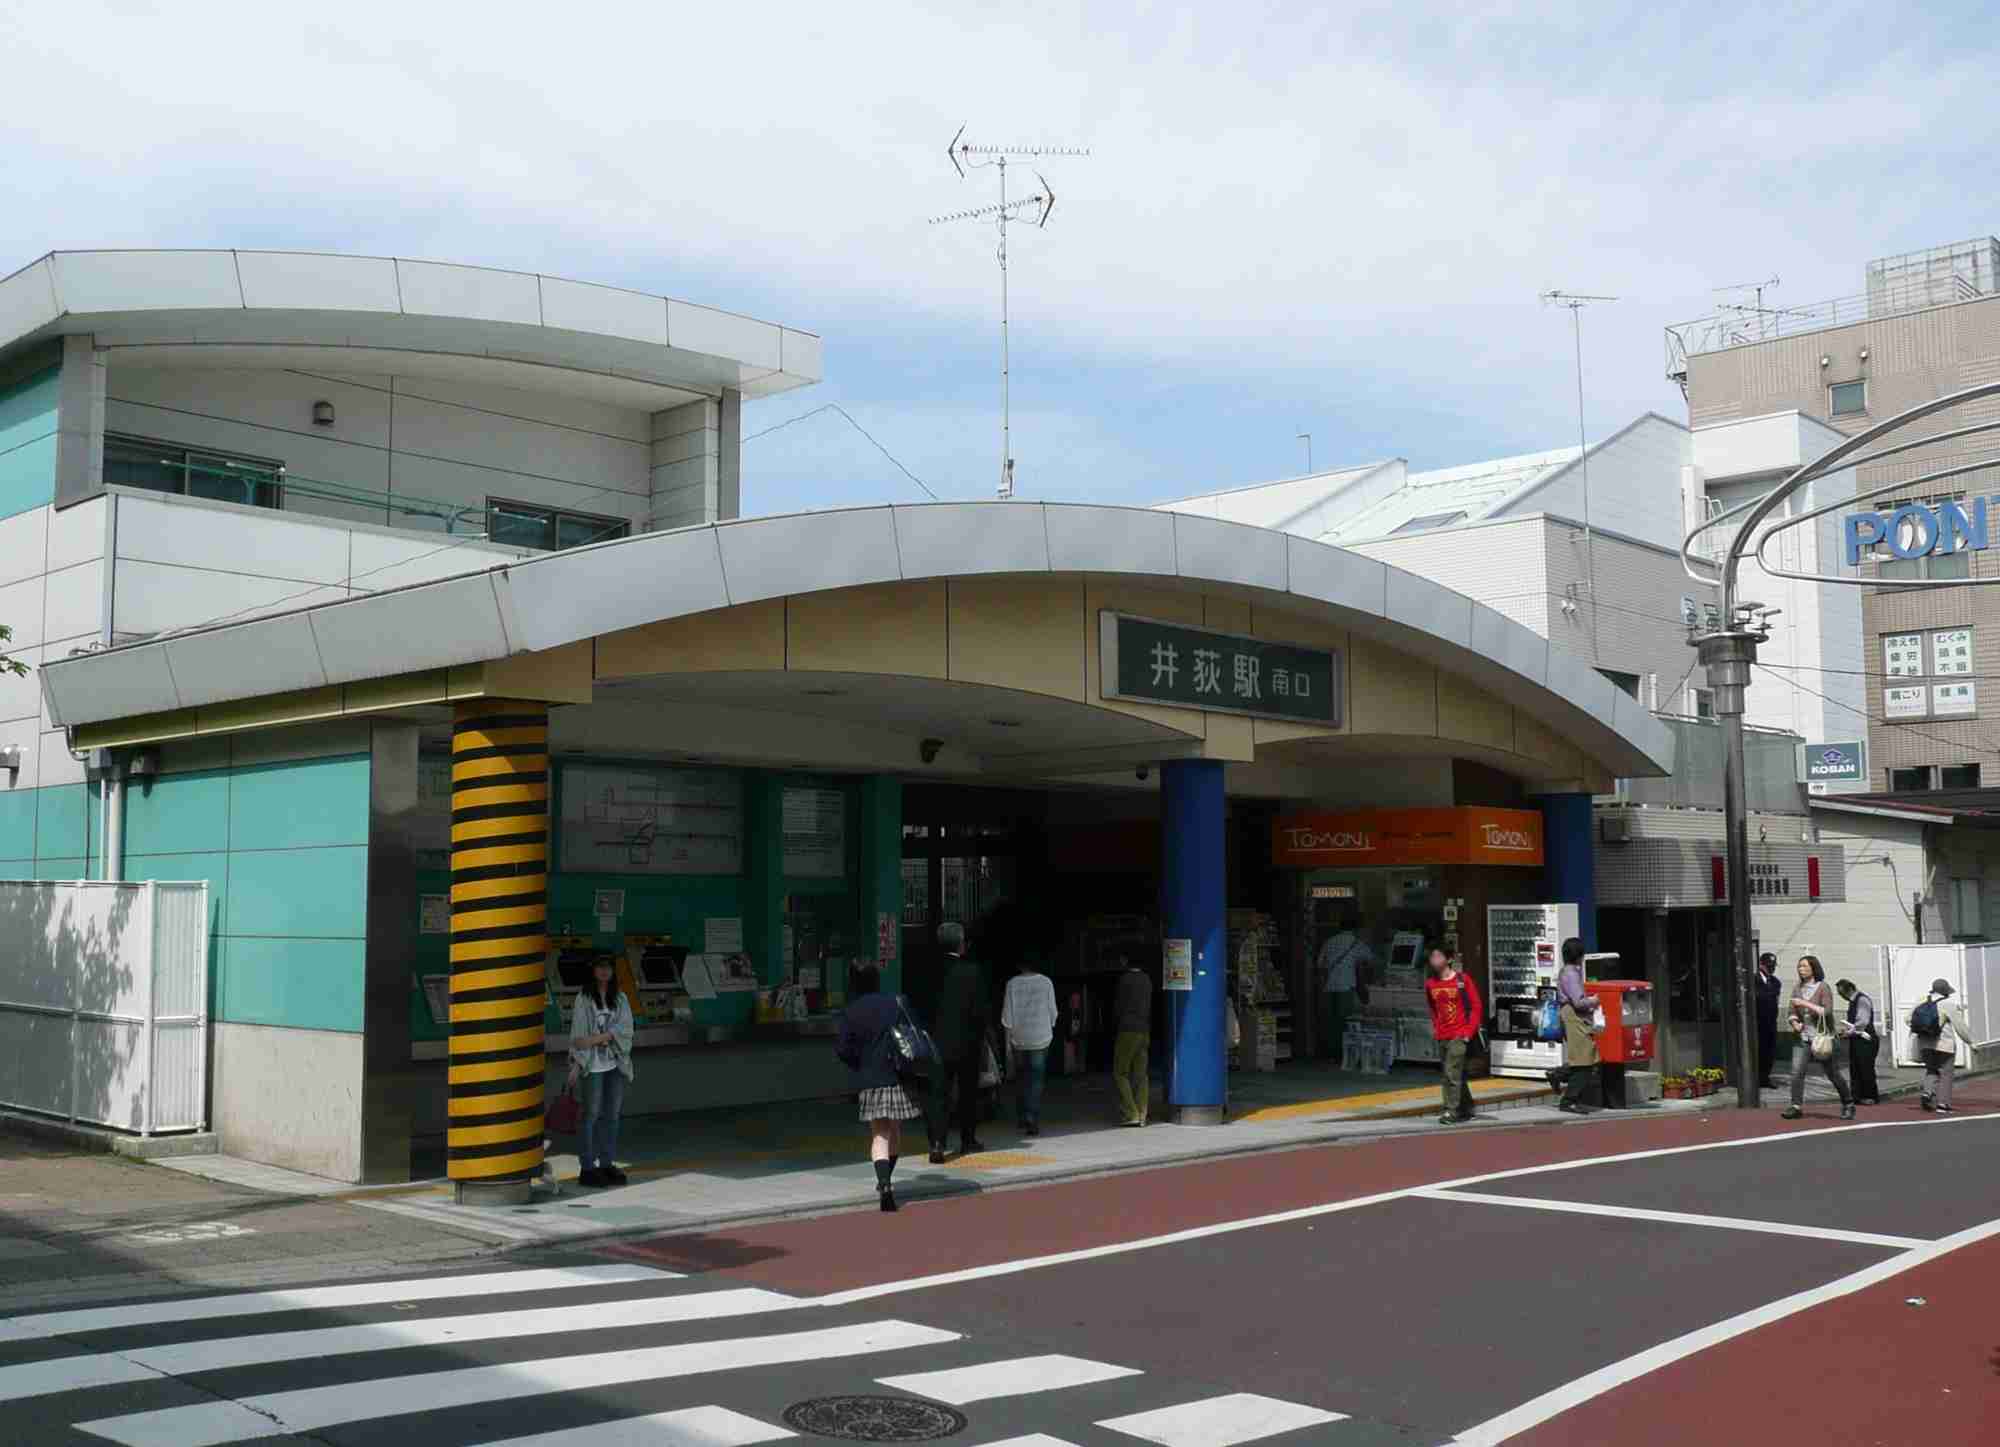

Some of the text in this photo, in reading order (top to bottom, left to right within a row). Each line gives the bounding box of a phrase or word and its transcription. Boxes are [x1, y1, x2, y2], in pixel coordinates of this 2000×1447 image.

[1845, 496, 2000, 566] PON
[1150, 641, 1311, 699] 井荻駅 南口
[1811, 763, 1856, 774] KOBAN
